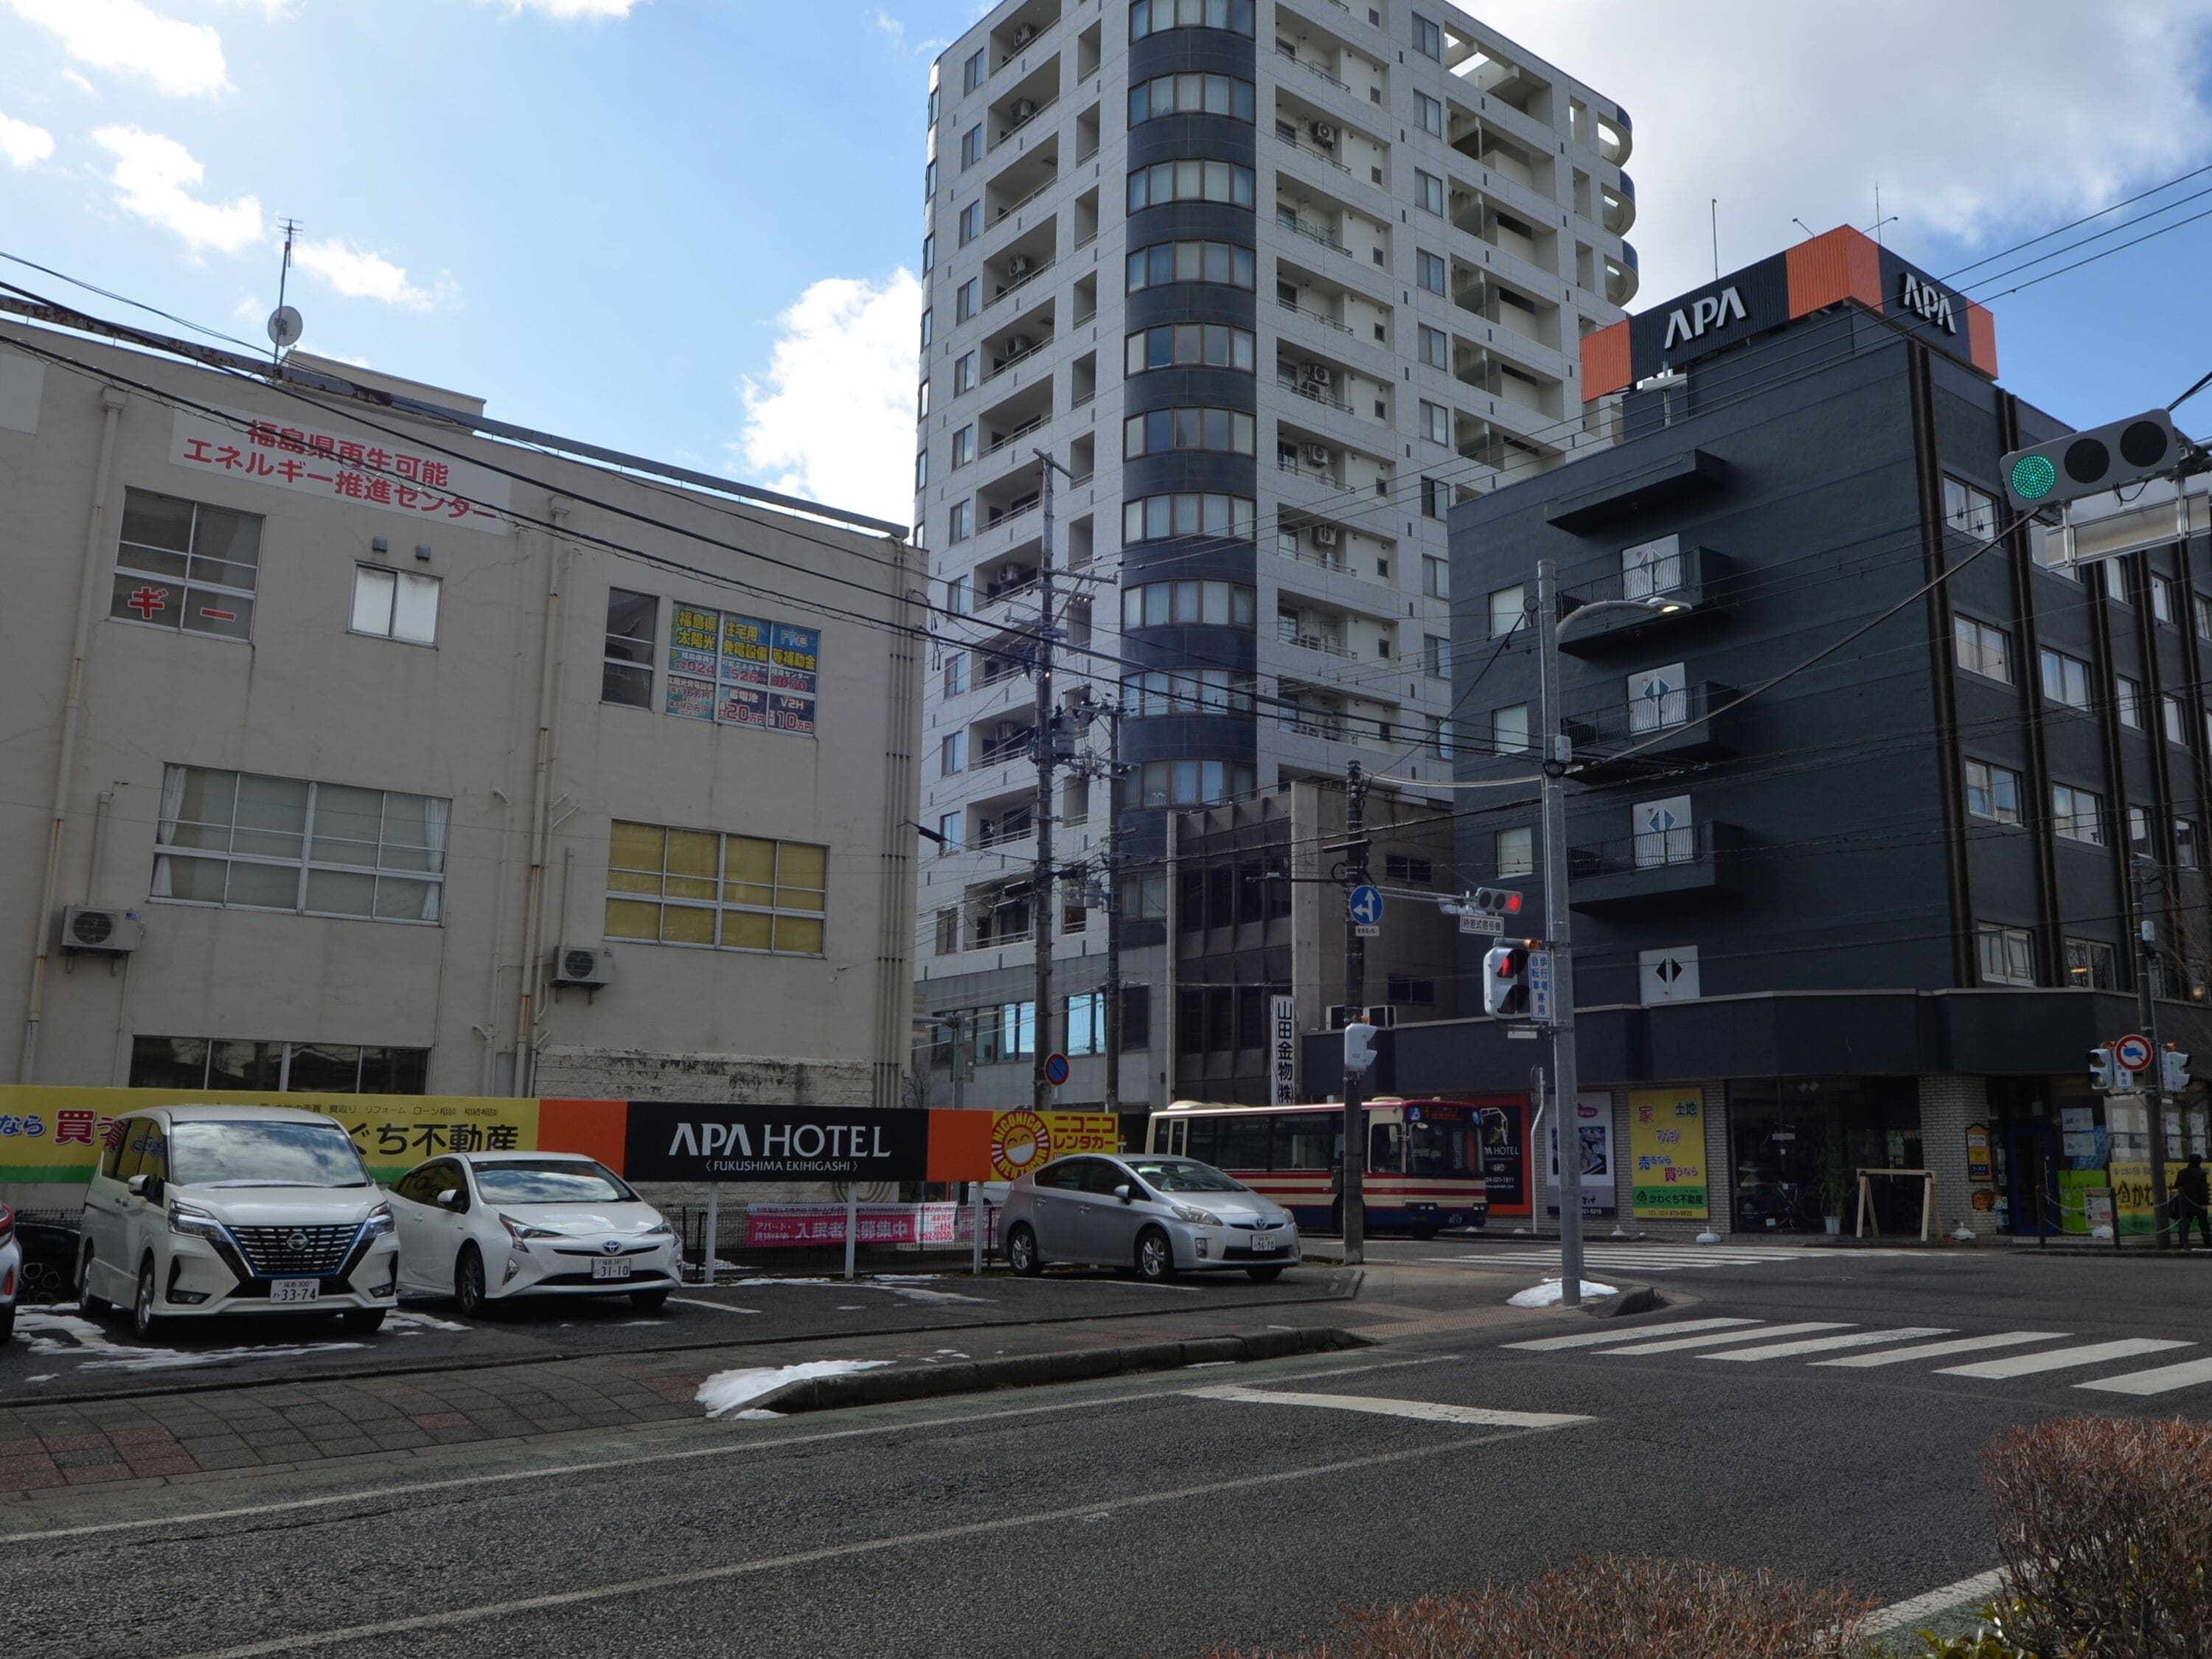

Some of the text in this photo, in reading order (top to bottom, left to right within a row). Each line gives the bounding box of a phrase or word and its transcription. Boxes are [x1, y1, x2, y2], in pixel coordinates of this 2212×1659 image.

[1902, 272, 1957, 335] APA
[1665, 286, 1746, 351] APA
[248, 419, 449, 487] 福島県再生可能
[183, 438, 497, 518] エネルギー推進センター
[678, 611, 759, 642] 福島県 住宅用
[677, 630, 716, 651] 太陽光
[780, 697, 804, 711] V2H
[364, 1106, 406, 1115] リフォーム
[1674, 1102, 1697, 1116] 土地
[992, 1113, 1043, 1142] NICONICO
[1053, 1116, 1116, 1134] ニコニコ
[669, 1123, 891, 1158] APA HOTEL
[1053, 1135, 1116, 1150] レンタカー
[1493, 1147, 1520, 1155] HOTEL
[601, 1265, 628, 1276] 31-10
[281, 1288, 316, 1301] 33-74
